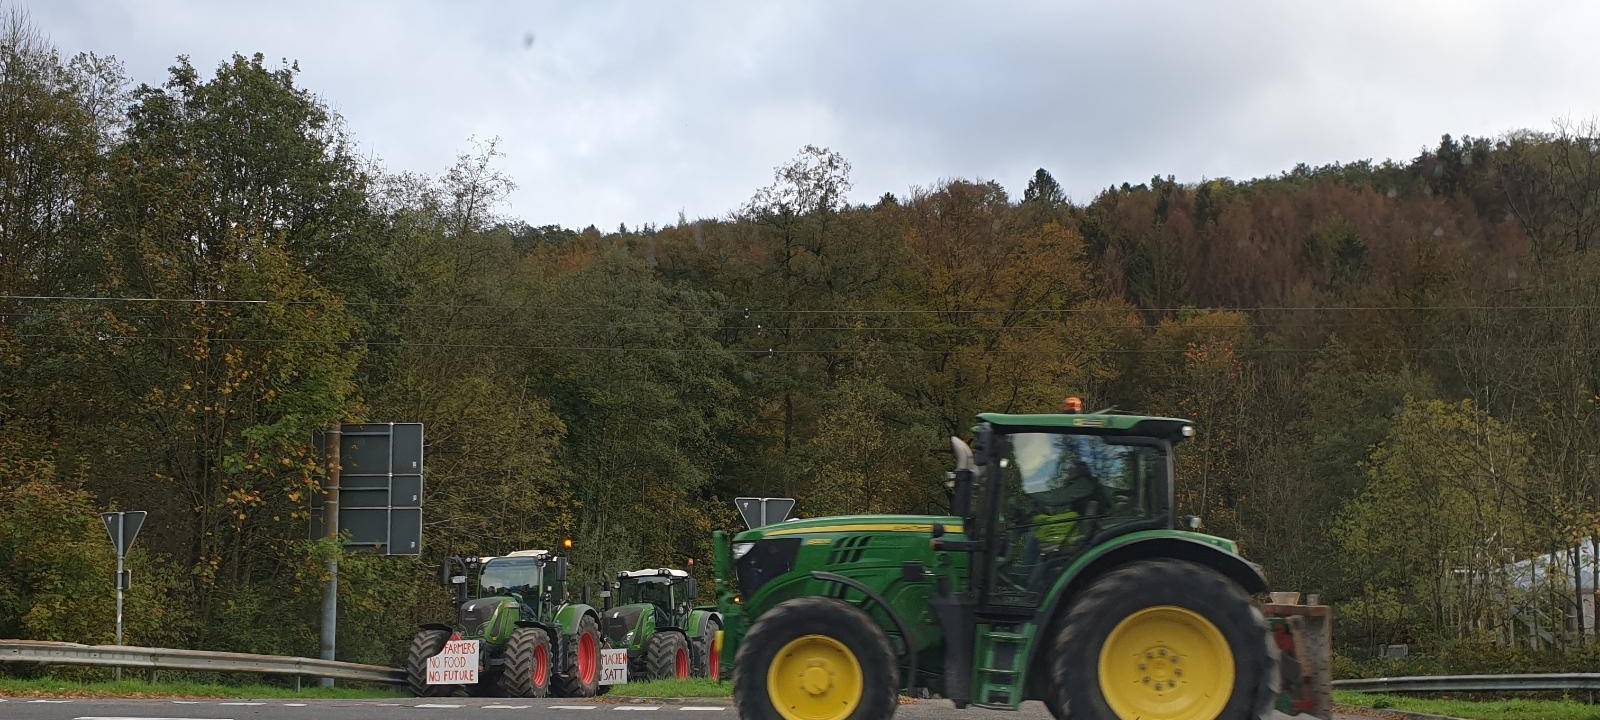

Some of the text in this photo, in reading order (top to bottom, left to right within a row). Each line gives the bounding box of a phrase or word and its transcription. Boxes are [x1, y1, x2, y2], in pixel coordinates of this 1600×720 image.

[444, 642, 476, 655] FARMERS
[429, 656, 467, 669] NO FOOD
[601, 653, 627, 665] MACHEN
[428, 669, 475, 682] NO FUTURE
[603, 668, 625, 681] SATT
